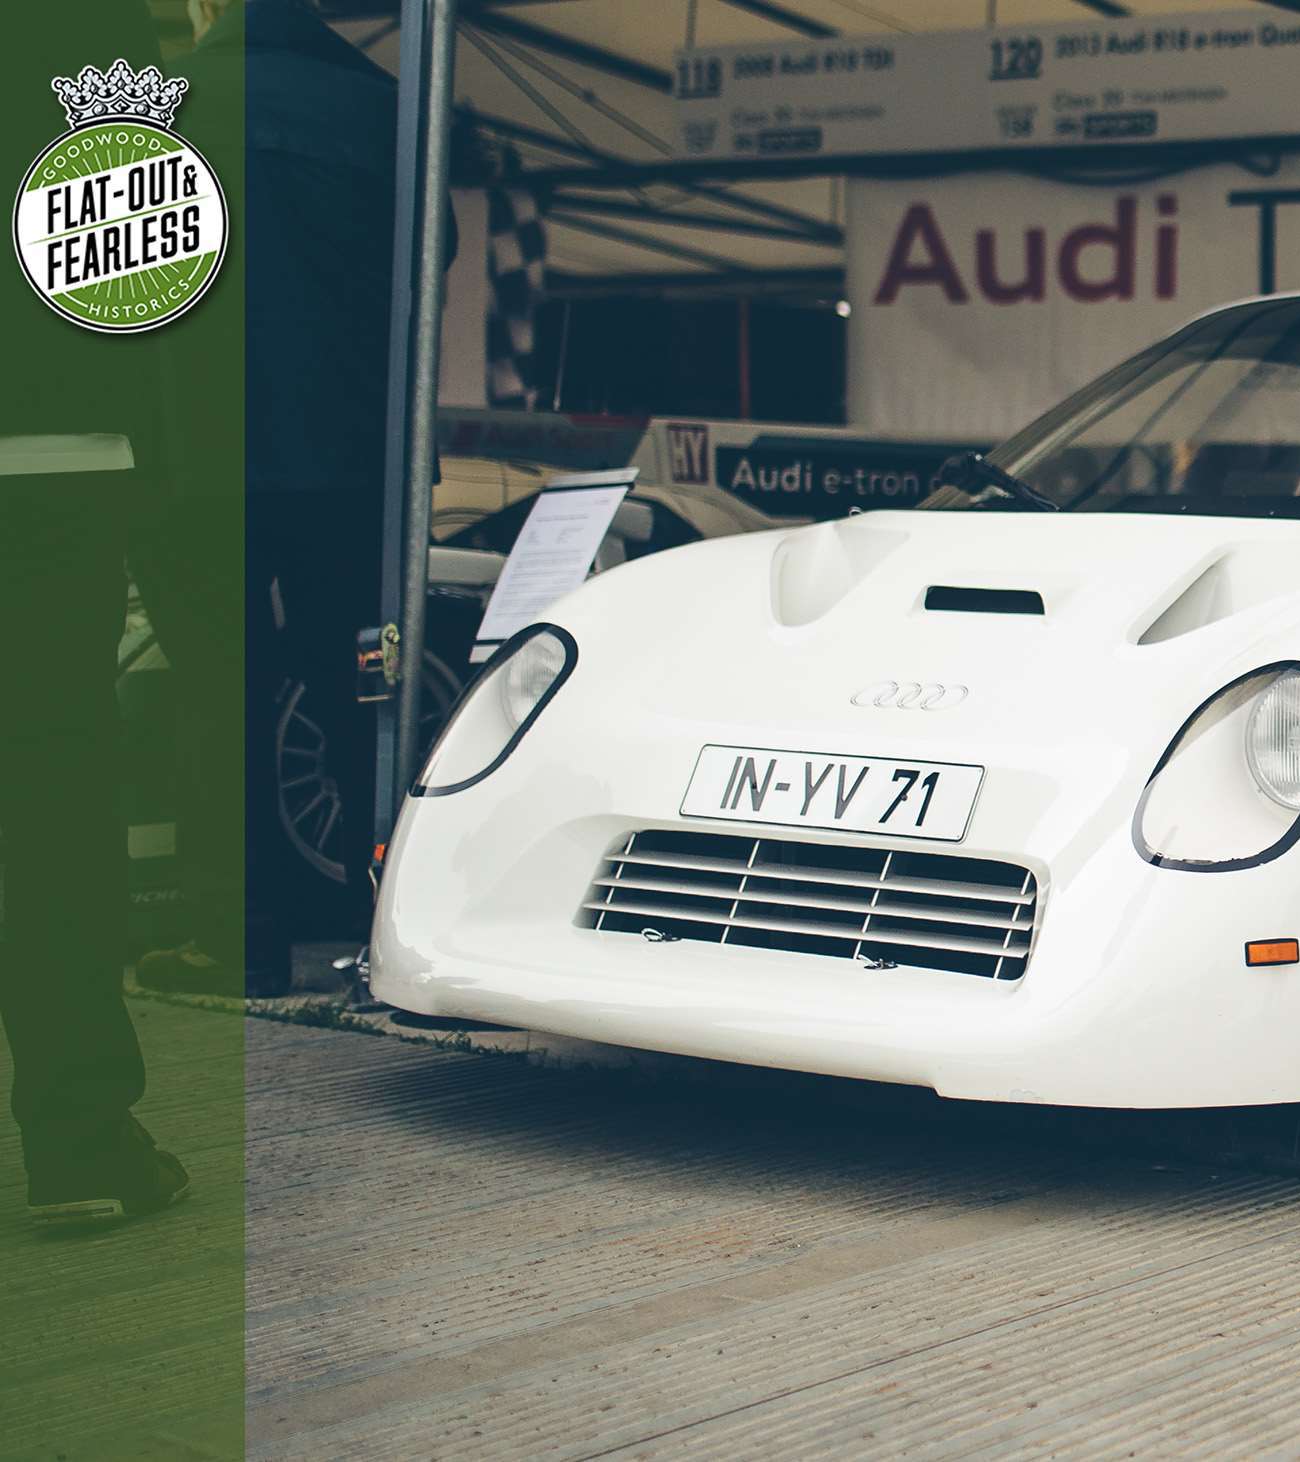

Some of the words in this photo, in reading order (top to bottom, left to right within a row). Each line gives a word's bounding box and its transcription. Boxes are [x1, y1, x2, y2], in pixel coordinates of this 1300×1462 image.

[989, 36, 1044, 76] 120
[873, 193, 1180, 307] Audi
[732, 458, 813, 493] Audi
[822, 467, 919, 497] e-tron
[719, 755, 870, 820] IN-YV
[878, 768, 941, 827] 71
